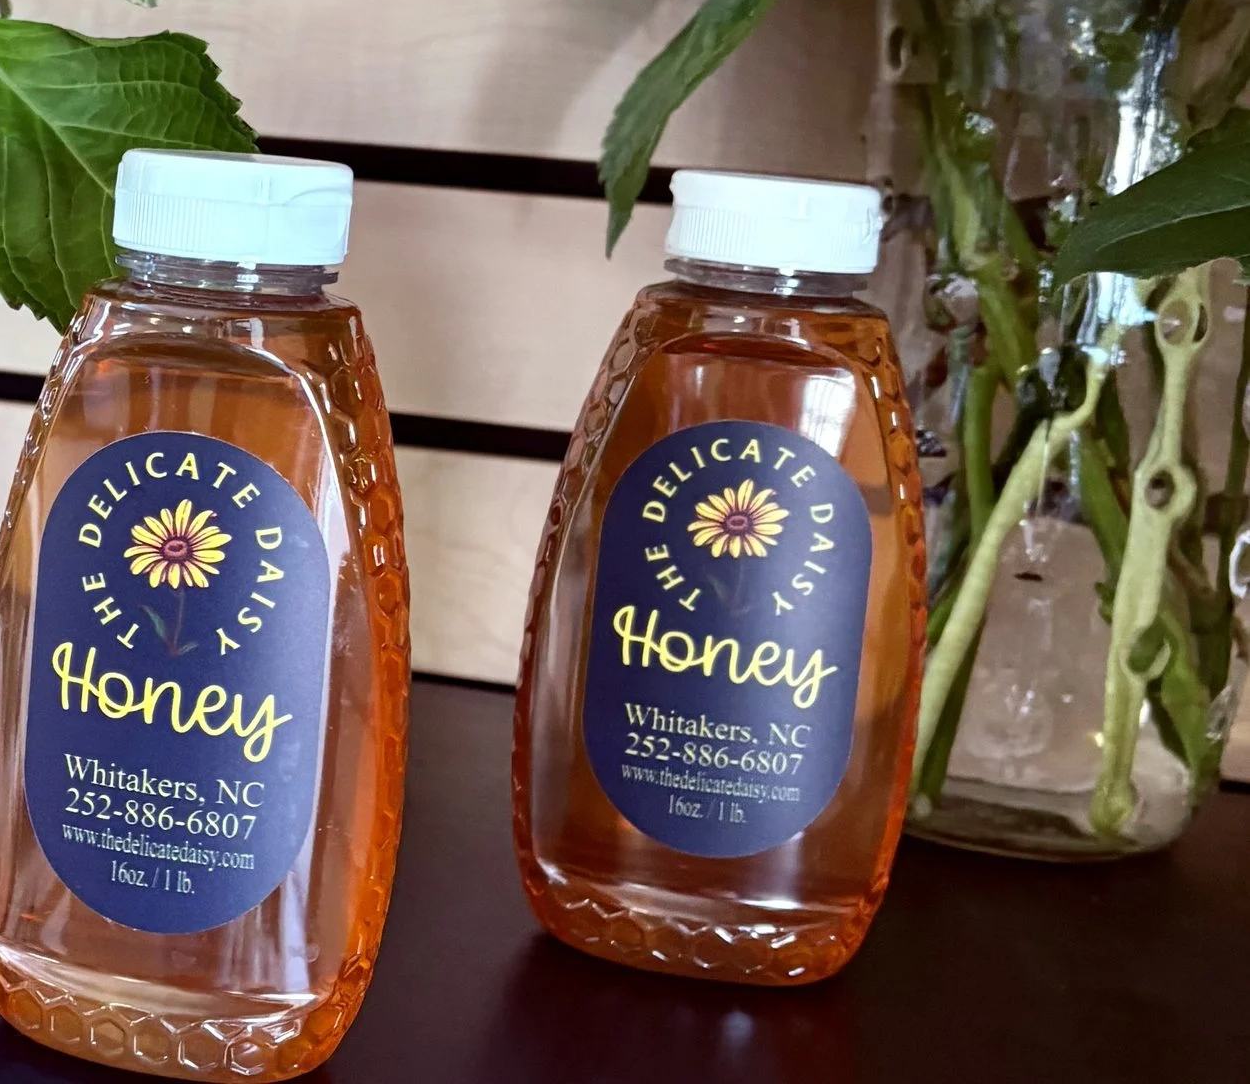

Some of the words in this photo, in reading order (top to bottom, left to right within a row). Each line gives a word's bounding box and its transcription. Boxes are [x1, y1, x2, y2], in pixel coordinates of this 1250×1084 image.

[79, 452, 261, 548] DELICATE
[642, 438, 816, 523] DELICATE
[216, 526, 284, 655] DAISY
[645, 544, 701, 611] THE
[772, 503, 835, 616] DAISY
[82, 573, 139, 649] THE
[613, 605, 838, 709] Honey
[52, 642, 293, 763] Honey
[768, 722, 811, 748] NC
[64, 753, 205, 806] Whitakers,
[216, 779, 265, 807] NC
[621, 763, 800, 803] www.thedelicatedaisy.com
[624, 732, 803, 776] 252-886-6807
[65, 787, 256, 840] 252-886-6807
[62, 824, 254, 872] www.thedelicatedaisy.com
[111, 860, 148, 887] 16oz.
[177, 870, 195, 894] lb.
